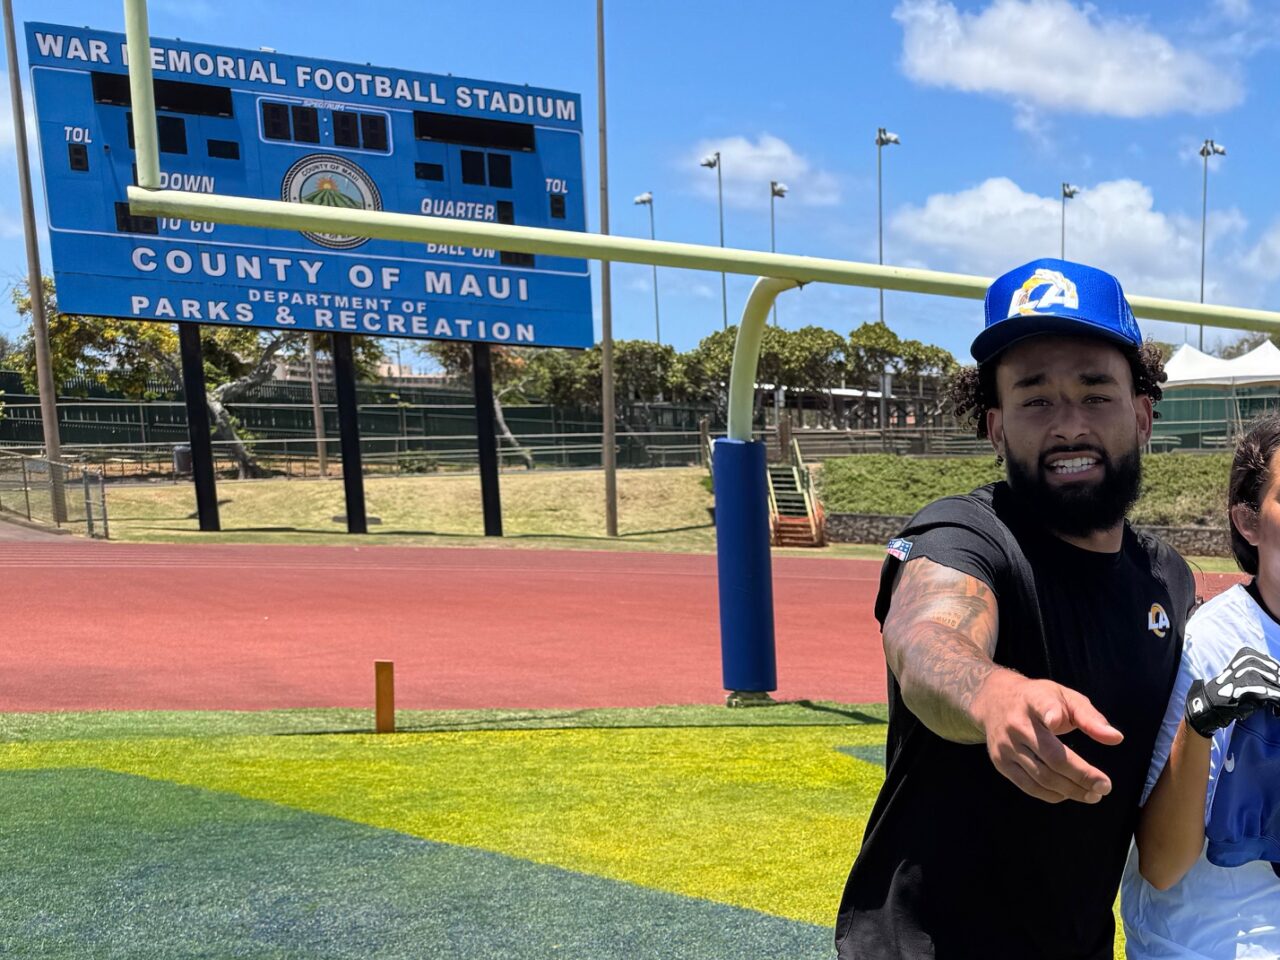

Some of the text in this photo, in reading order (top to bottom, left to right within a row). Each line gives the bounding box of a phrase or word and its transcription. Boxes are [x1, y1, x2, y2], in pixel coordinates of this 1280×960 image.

[35, 32, 576, 121] WAR EMORIAL FOOTBALL STADIUM
[64, 126, 93, 144] TOL
[159, 172, 215, 193] DOWN
[301, 163, 329, 177] COUNTY
[341, 168, 360, 183] MAUI
[545, 178, 569, 194] TOL
[421, 198, 495, 221] QUARTER
[131, 247, 528, 301] COUNTY OF MAUI
[249, 289, 427, 314] DEPARTMENT OF
[131, 295, 535, 342] PARKS & RECREATION
